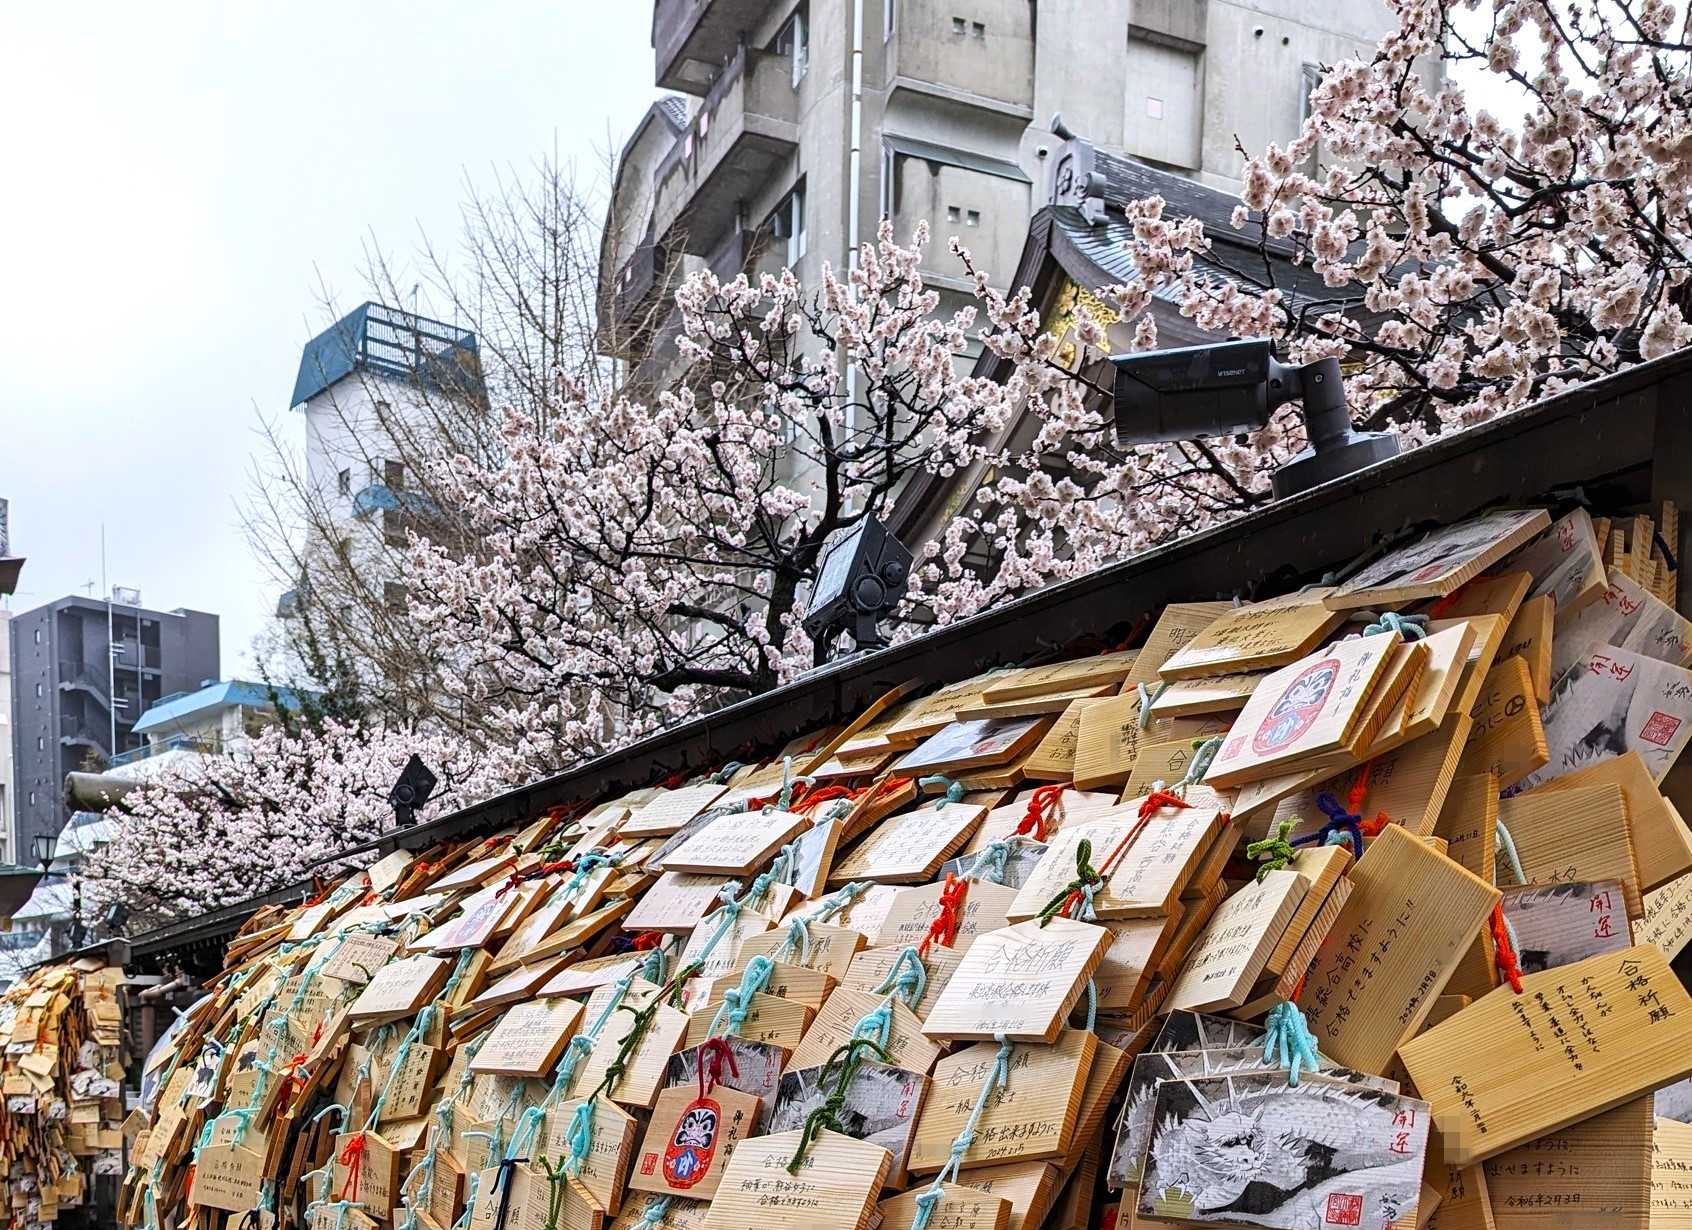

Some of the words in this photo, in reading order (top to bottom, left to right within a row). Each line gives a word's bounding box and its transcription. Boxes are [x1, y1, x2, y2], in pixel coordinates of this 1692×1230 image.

[1588, 653, 1635, 683] 開運
[1589, 890, 1620, 939] 開運
[984, 938, 1081, 975] 合格祈願
[1616, 959, 1677, 1026] 合格祈願
[947, 1052, 1031, 1087] 合格願
[896, 1080, 916, 1120] 開運
[1388, 1108, 1416, 1155] 開運
[763, 1153, 817, 1170] 合格願
